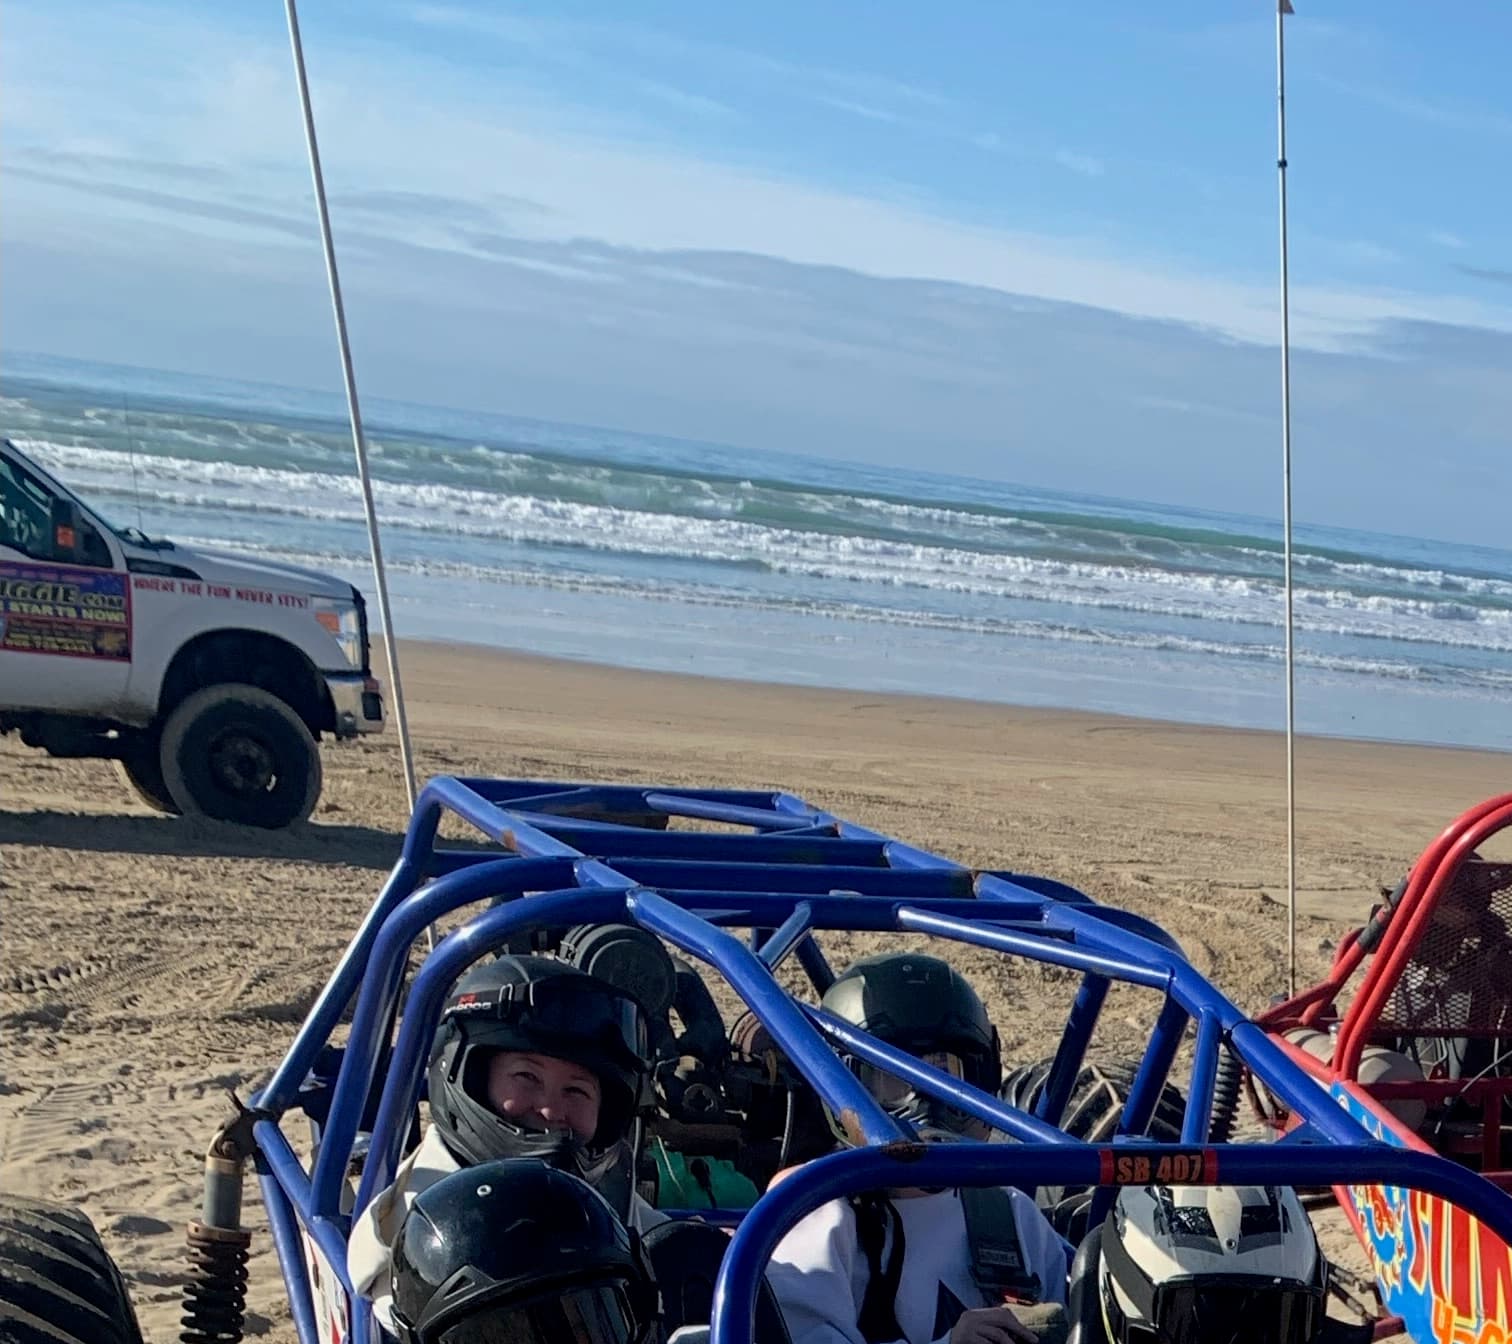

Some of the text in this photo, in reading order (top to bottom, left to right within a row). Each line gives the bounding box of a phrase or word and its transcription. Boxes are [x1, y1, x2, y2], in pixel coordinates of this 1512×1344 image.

[134, 578, 176, 593] WHERE
[181, 582, 202, 595] THE
[207, 584, 231, 599] FUN
[236, 588, 273, 604] NEVER
[9, 601, 78, 618] STARTS
[1116, 1154, 1203, 1183] SB 407
